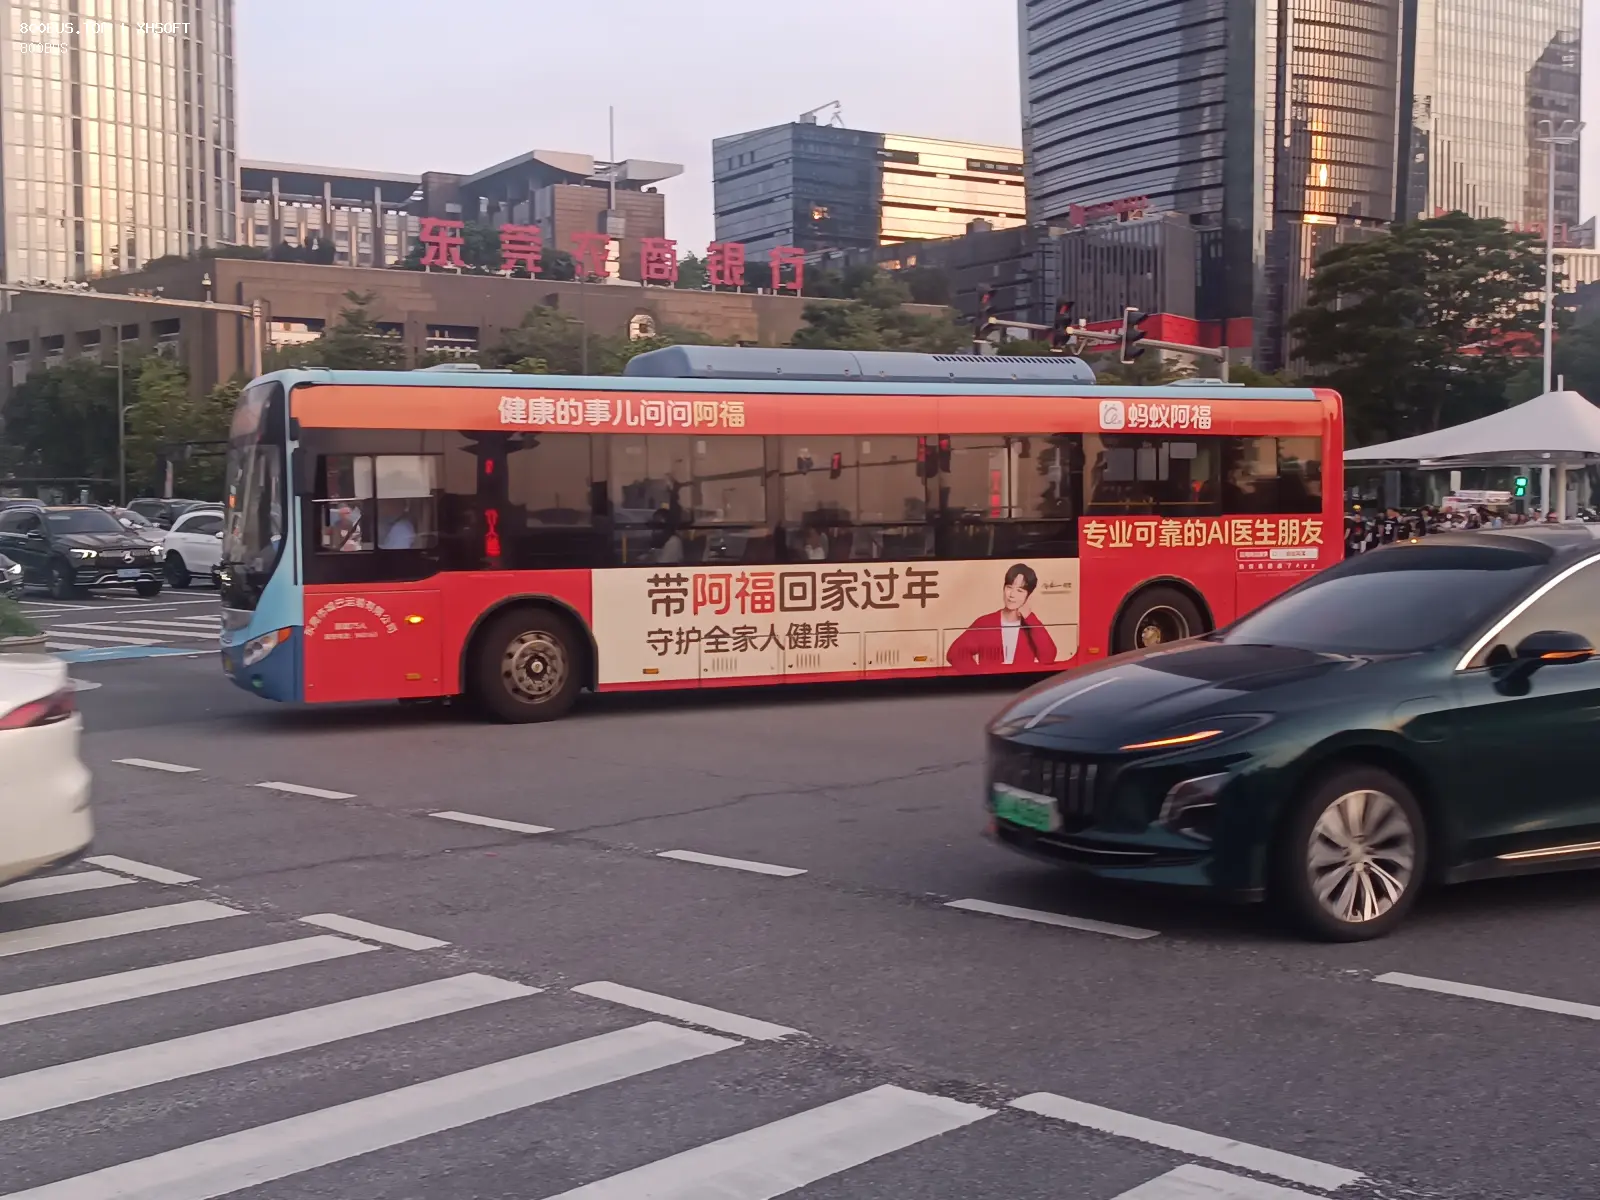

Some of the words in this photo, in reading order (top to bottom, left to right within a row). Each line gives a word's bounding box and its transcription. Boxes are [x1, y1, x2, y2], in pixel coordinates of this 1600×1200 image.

[420, 217, 805, 290] 东莞农商银行
[498, 396, 745, 428] 健康的事儿问问阿福
[1127, 403, 1212, 430] 蚂蚁阿福
[1082, 518, 1324, 549] 专业可靠的AI医生朋友
[647, 567, 940, 617] 带阿福回家过年
[647, 621, 840, 657] 守护全家人健康
